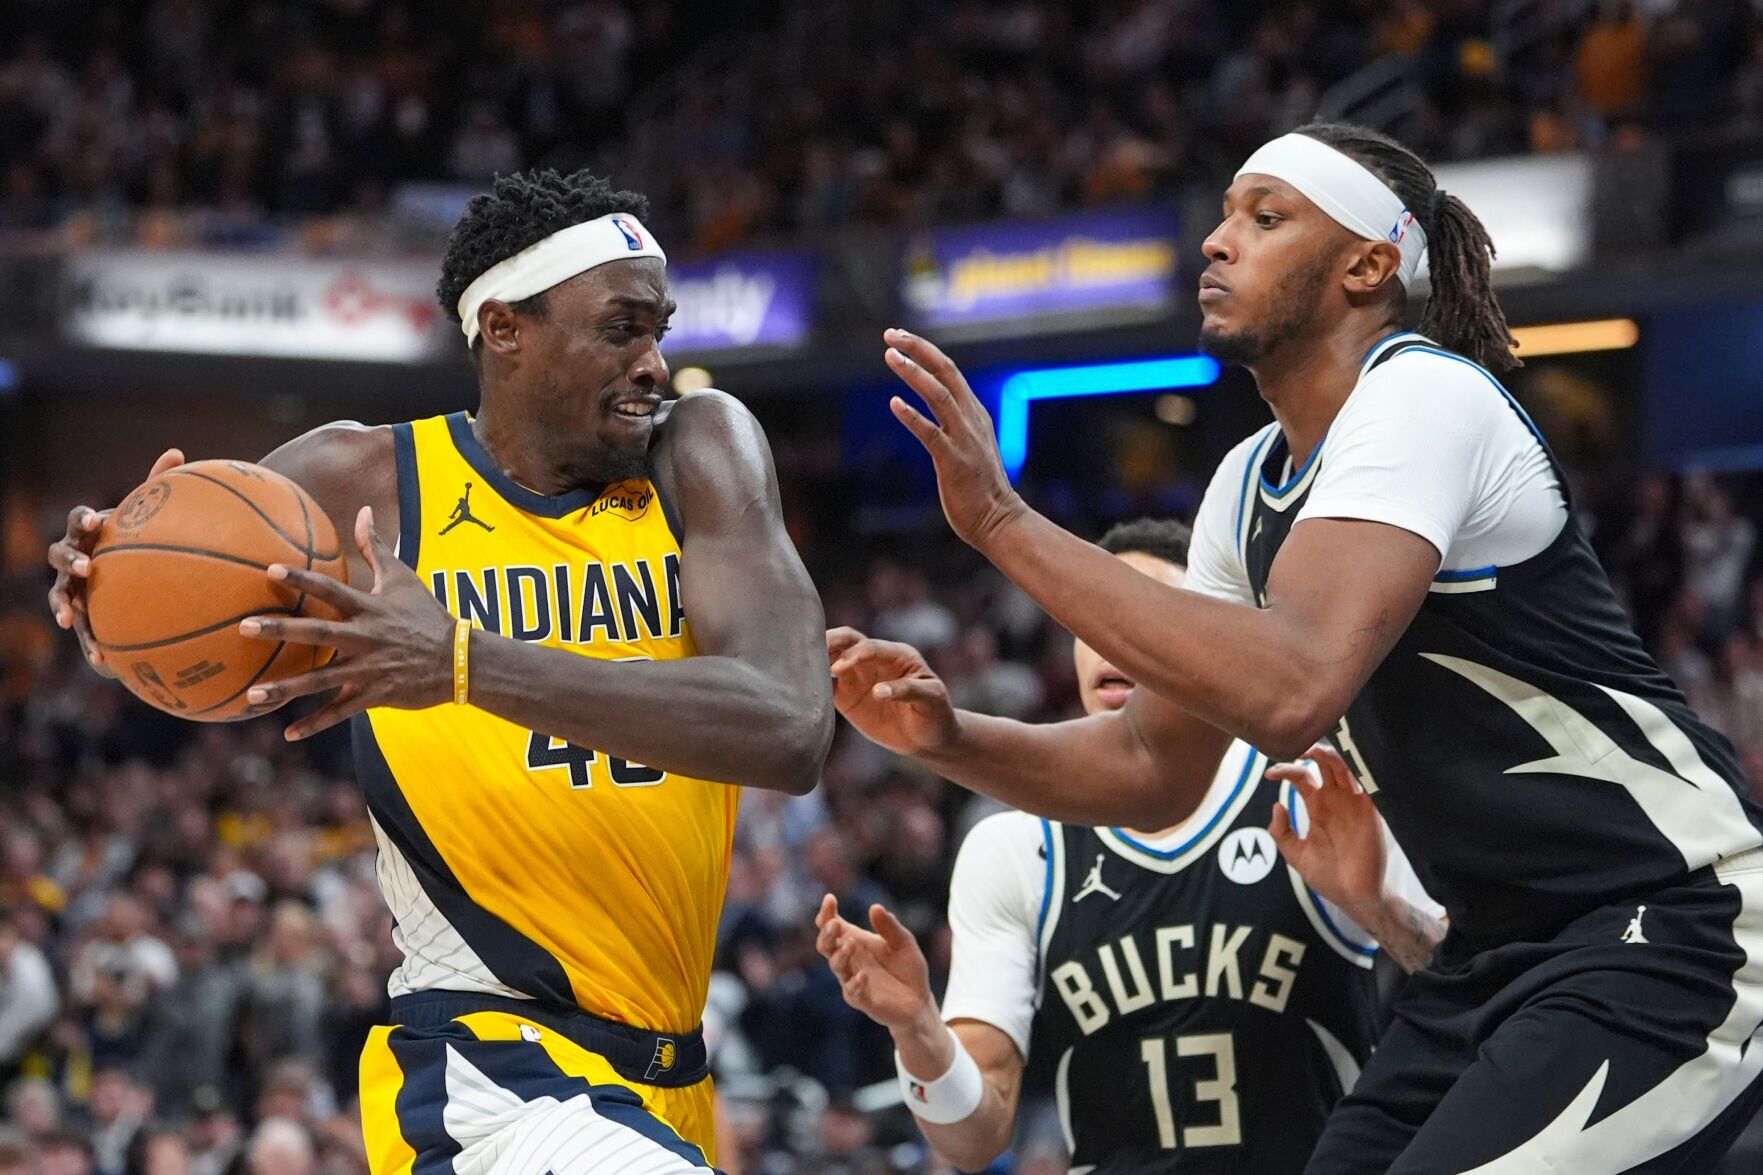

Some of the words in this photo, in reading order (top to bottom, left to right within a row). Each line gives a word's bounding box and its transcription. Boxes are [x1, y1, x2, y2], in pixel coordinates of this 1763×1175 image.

[592, 496, 633, 517] LUCAS
[431, 552, 687, 645] INDIANA
[1051, 924, 1306, 1036] BUCKS
[1141, 1033, 1241, 1149] 13
